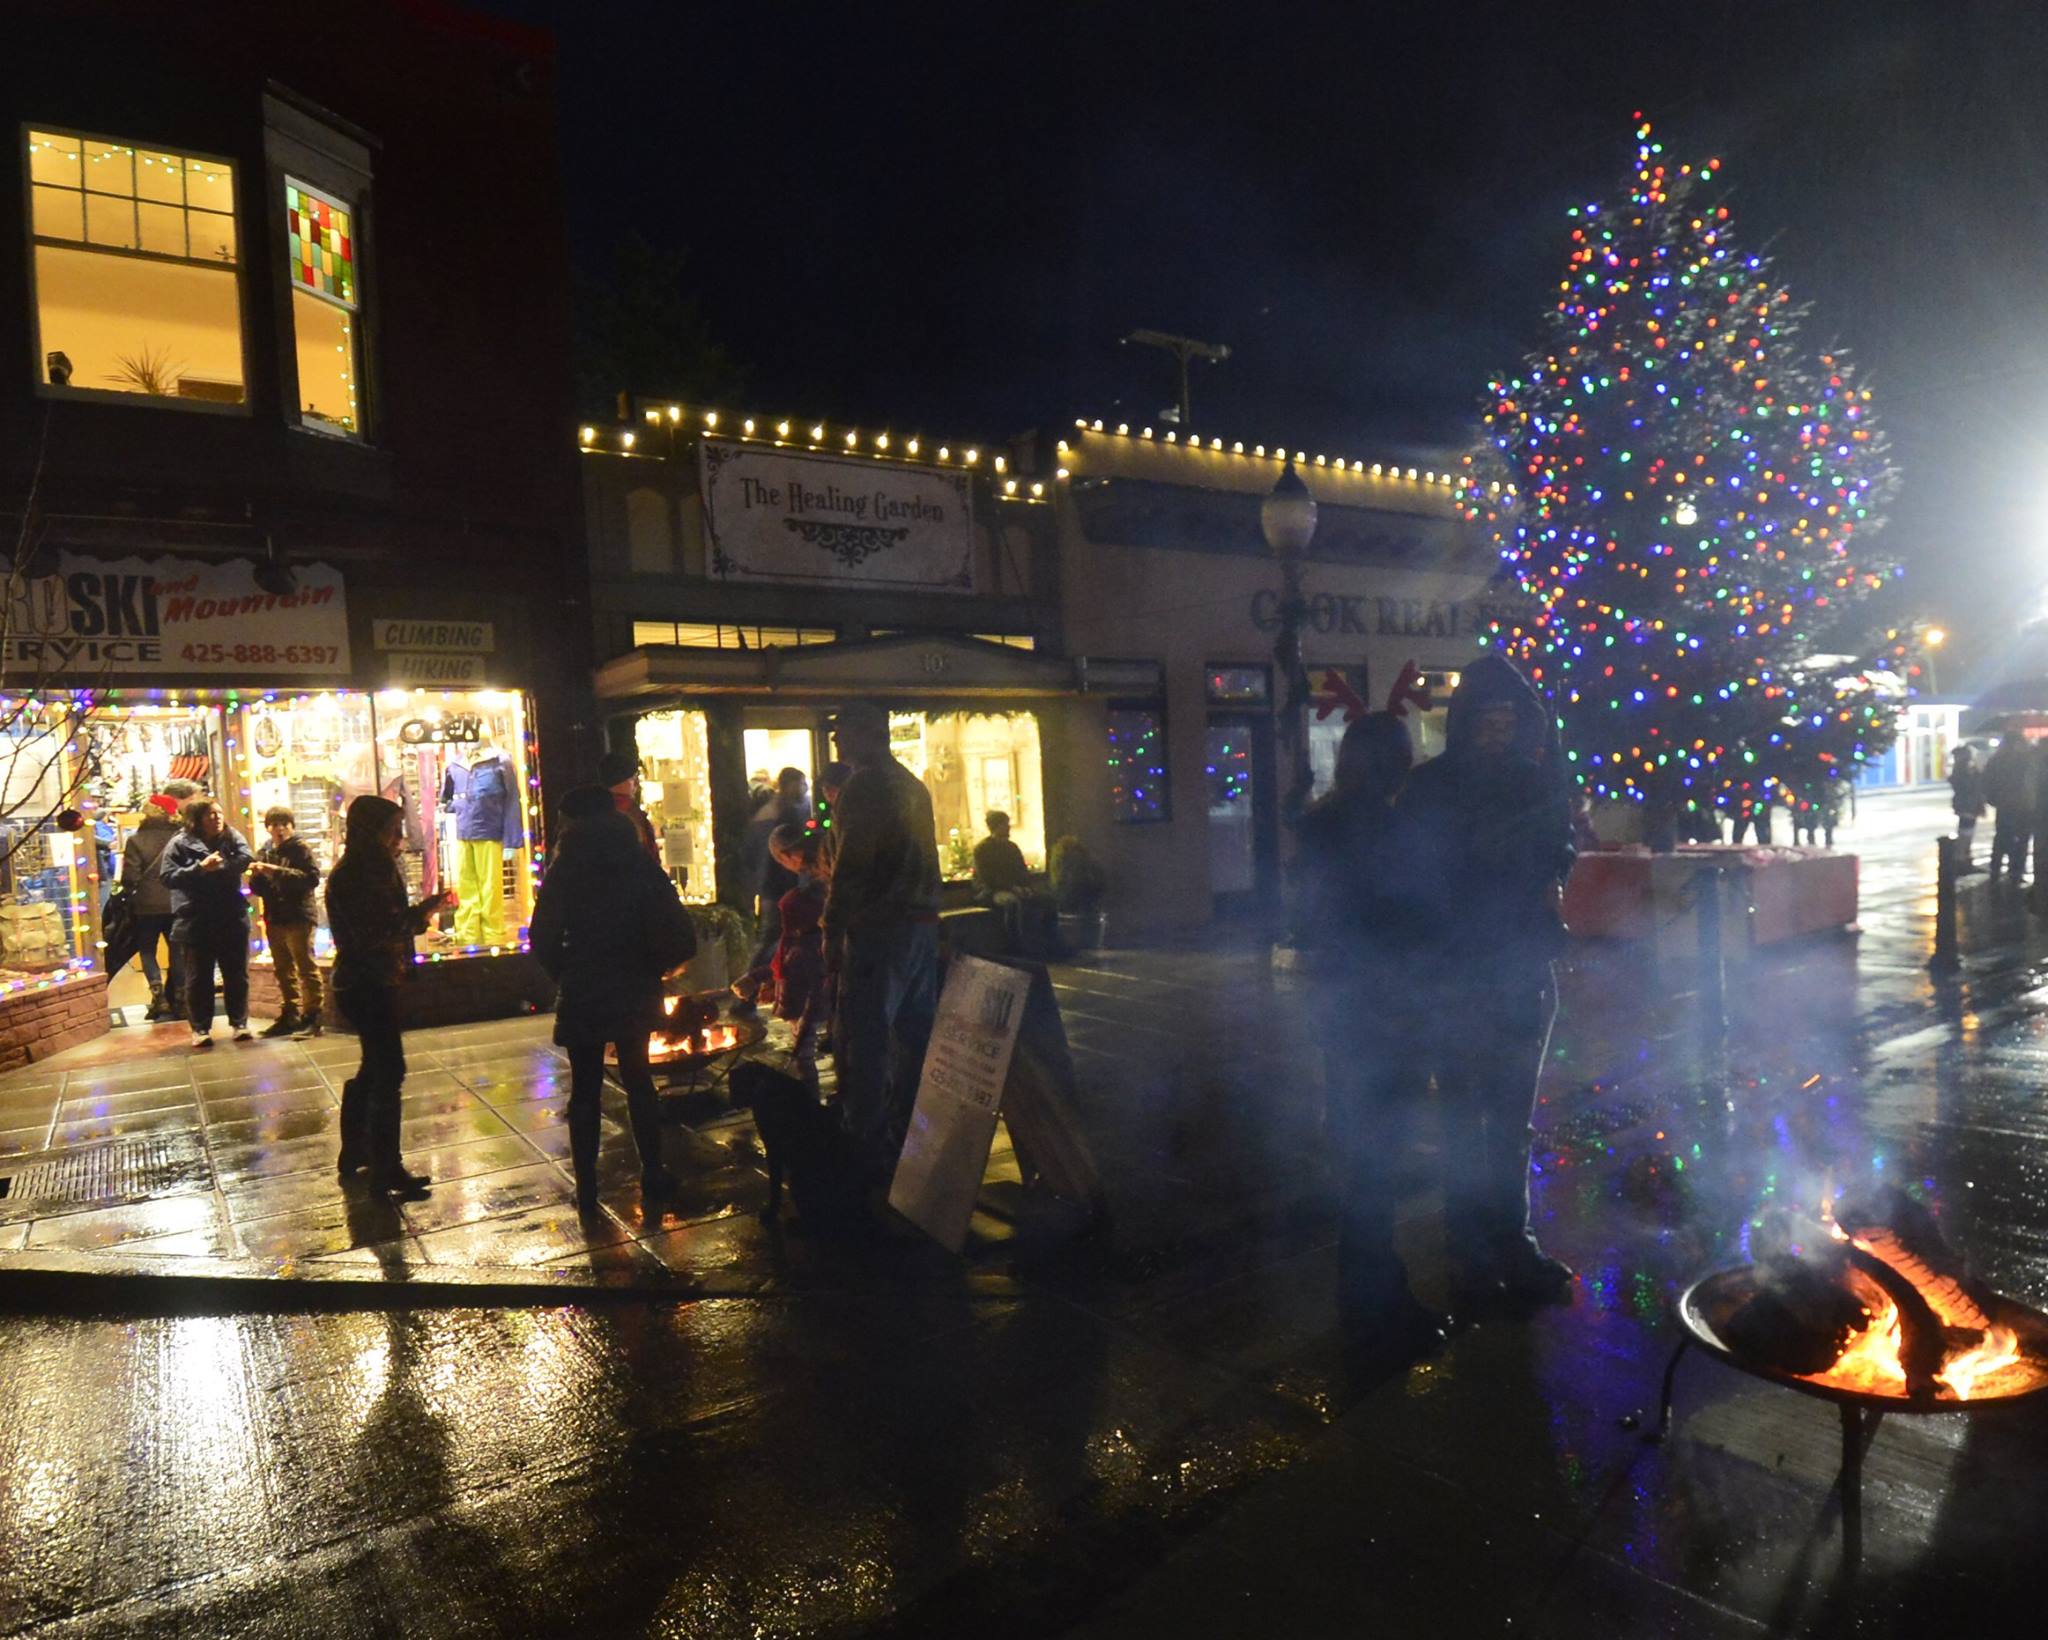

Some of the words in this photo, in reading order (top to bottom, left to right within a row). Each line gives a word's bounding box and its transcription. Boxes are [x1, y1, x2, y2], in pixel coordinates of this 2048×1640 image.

[740, 477, 780, 508] The
[787, 482, 867, 520] Healing
[874, 491, 944, 523] Garden
[164, 584, 335, 624] Mountain
[1250, 589, 1367, 634] COK
[385, 622, 483, 647] CLIMBING
[0, 641, 161, 664] ERVICE
[181, 643, 339, 665] 425-888-6397
[401, 656, 473, 680] HIKING
